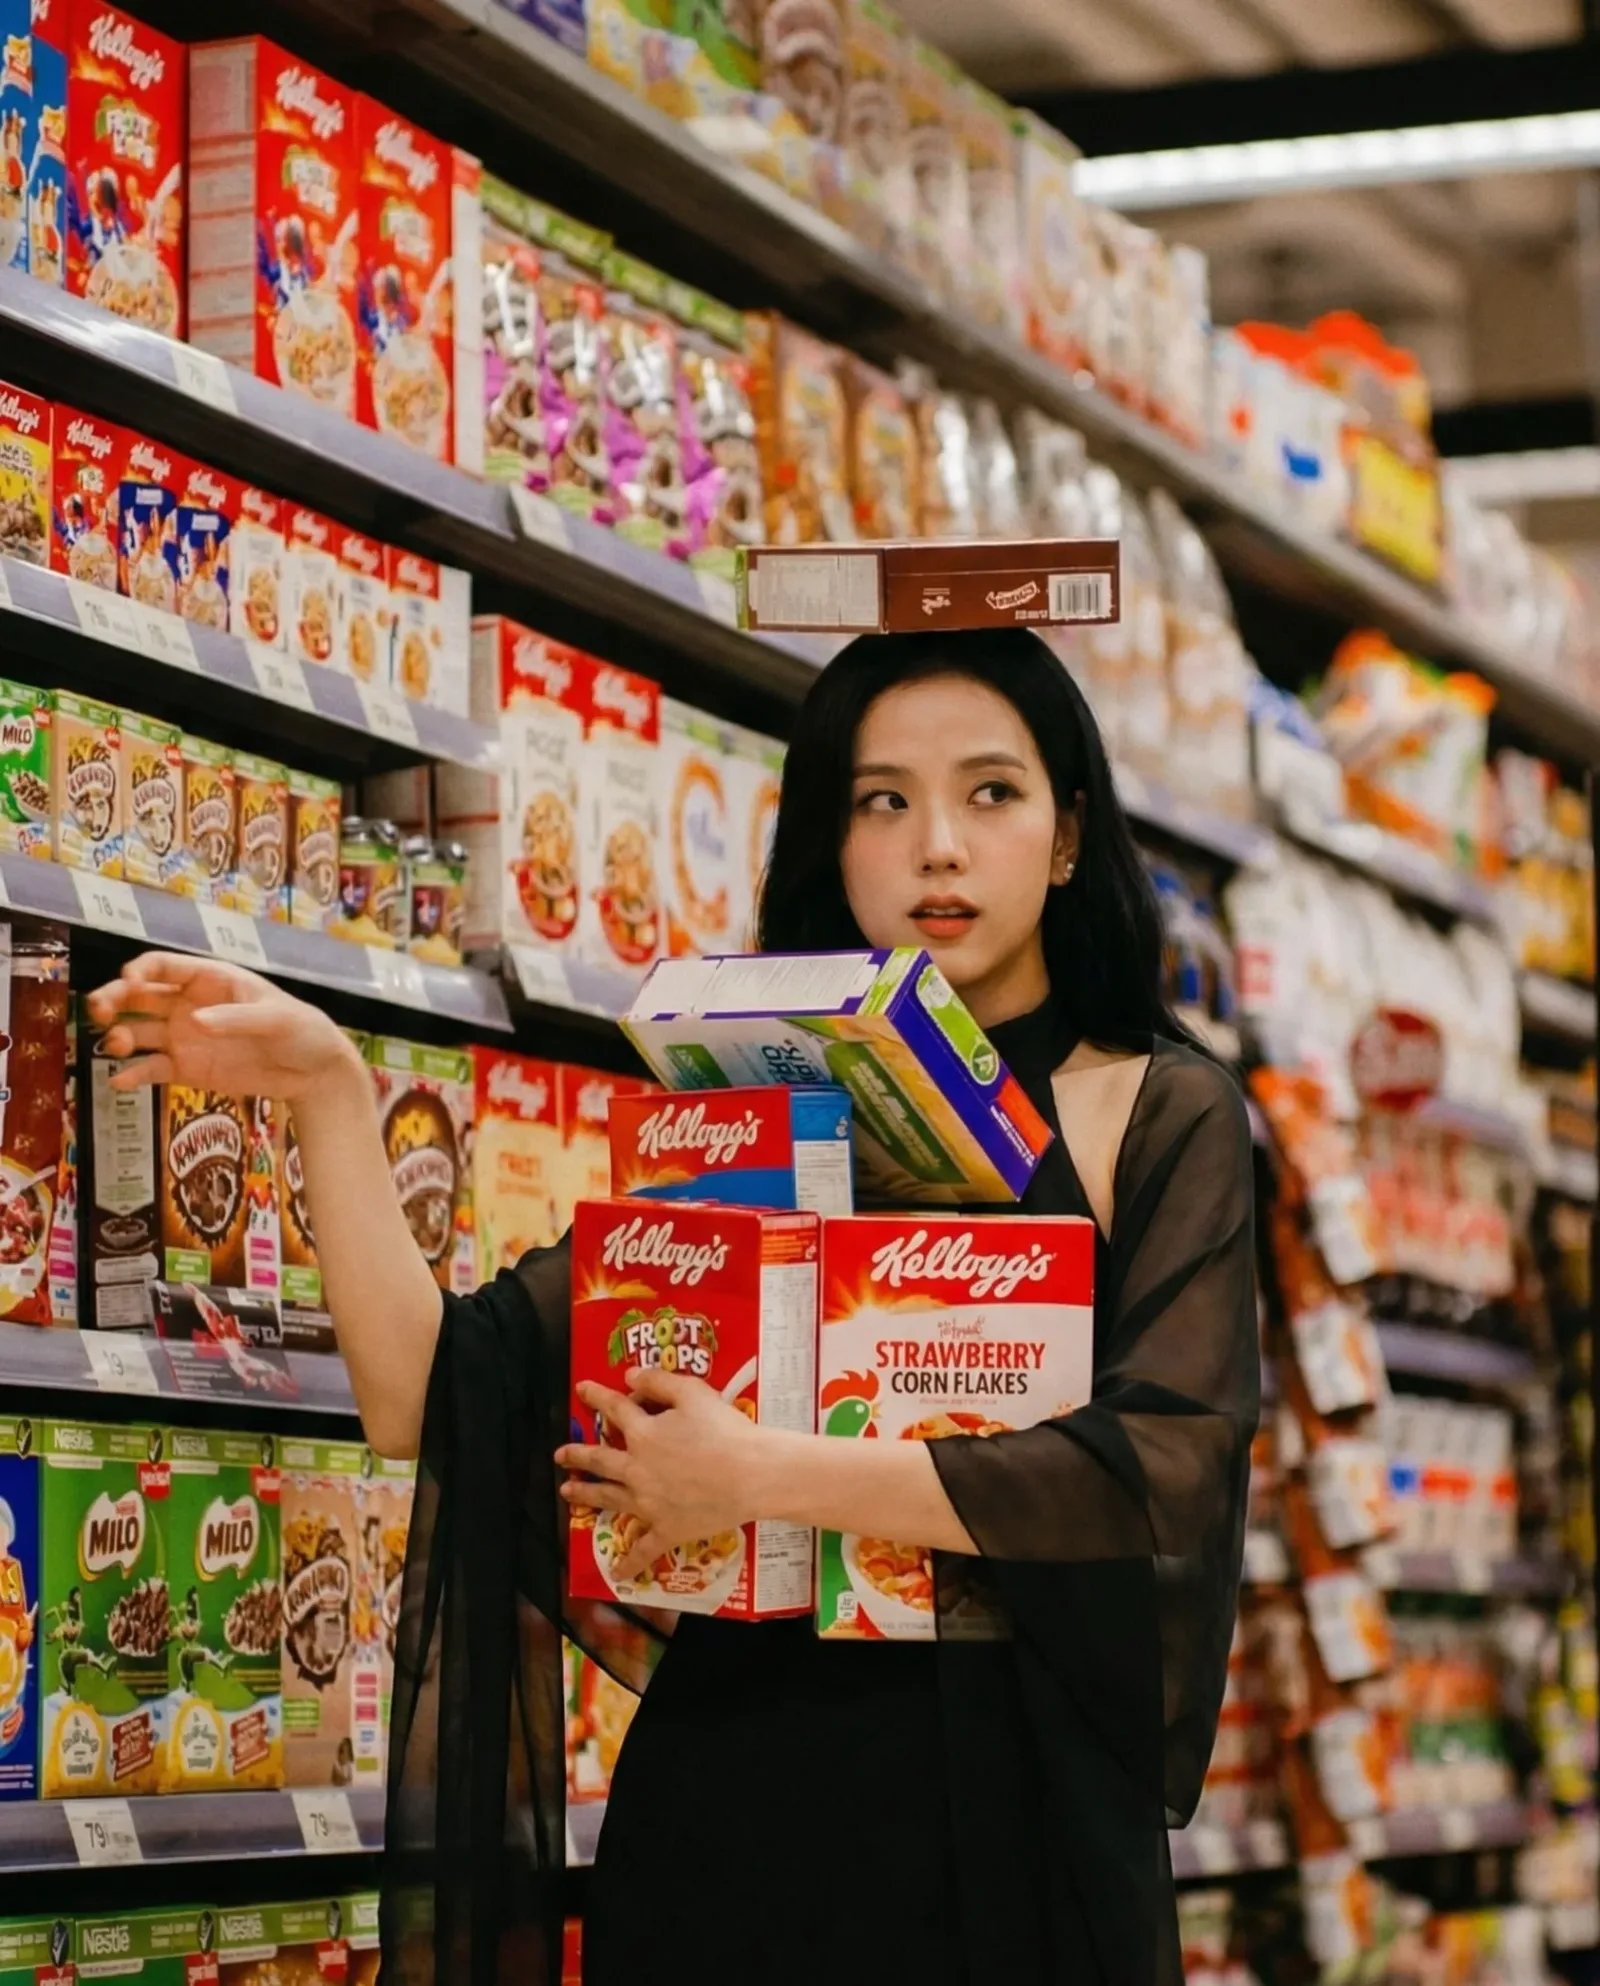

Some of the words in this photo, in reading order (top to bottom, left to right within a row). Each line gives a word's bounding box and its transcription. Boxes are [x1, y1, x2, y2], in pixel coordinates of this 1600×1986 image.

[3, 725, 33, 746] MILO
[637, 1104, 763, 1164] Kellogg's
[602, 1216, 730, 1286] Kellogg's
[869, 1229, 1056, 1299] Kellogg's
[626, 1316, 703, 1356] FROOT
[638, 1347, 711, 1376] LOOPS
[875, 1340, 1046, 1370] STRAWBERRY
[891, 1371, 948, 1395] CORN
[953, 1371, 1028, 1395] FLAKES
[88, 1516, 140, 1559] MILO
[205, 1520, 253, 1560] MILO
[84, 1822, 107, 1849] 79
[82, 1923, 131, 1956] Nestlé
